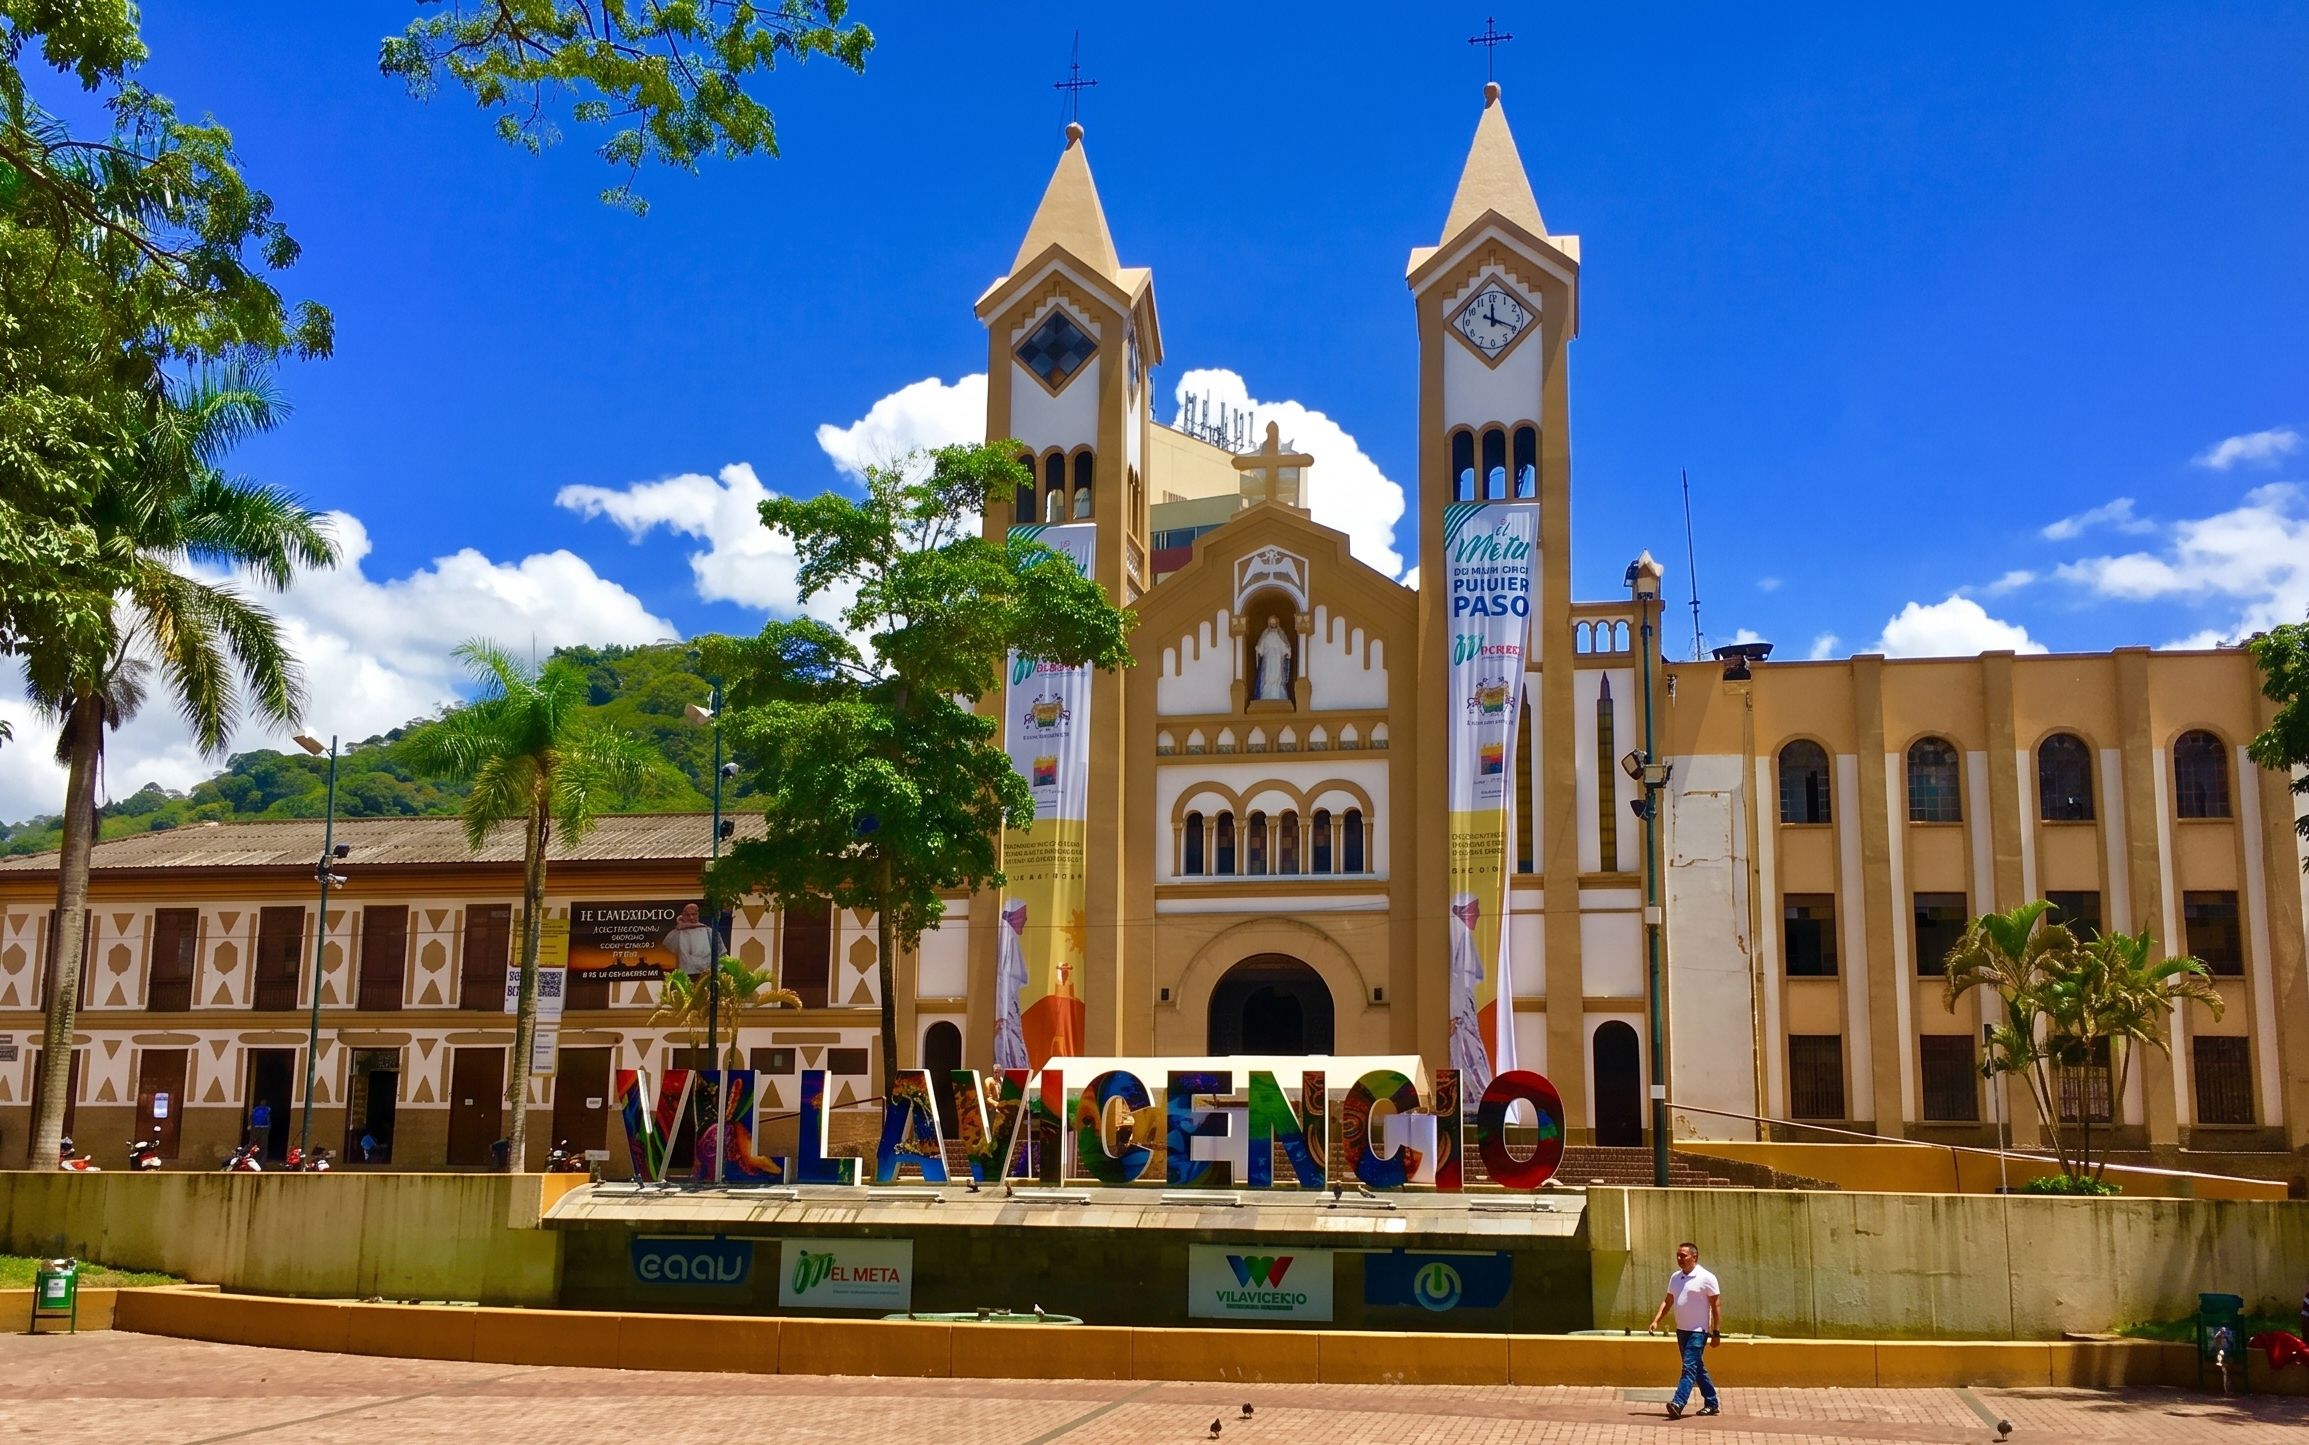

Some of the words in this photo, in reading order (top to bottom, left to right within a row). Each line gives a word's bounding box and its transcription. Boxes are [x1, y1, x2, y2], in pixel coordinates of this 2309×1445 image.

[1453, 594, 1530, 618] PASO
[615, 1069, 1567, 1189] VILLAVICENCIO
[831, 1266, 849, 1282] EL
[853, 1267, 900, 1283] META
